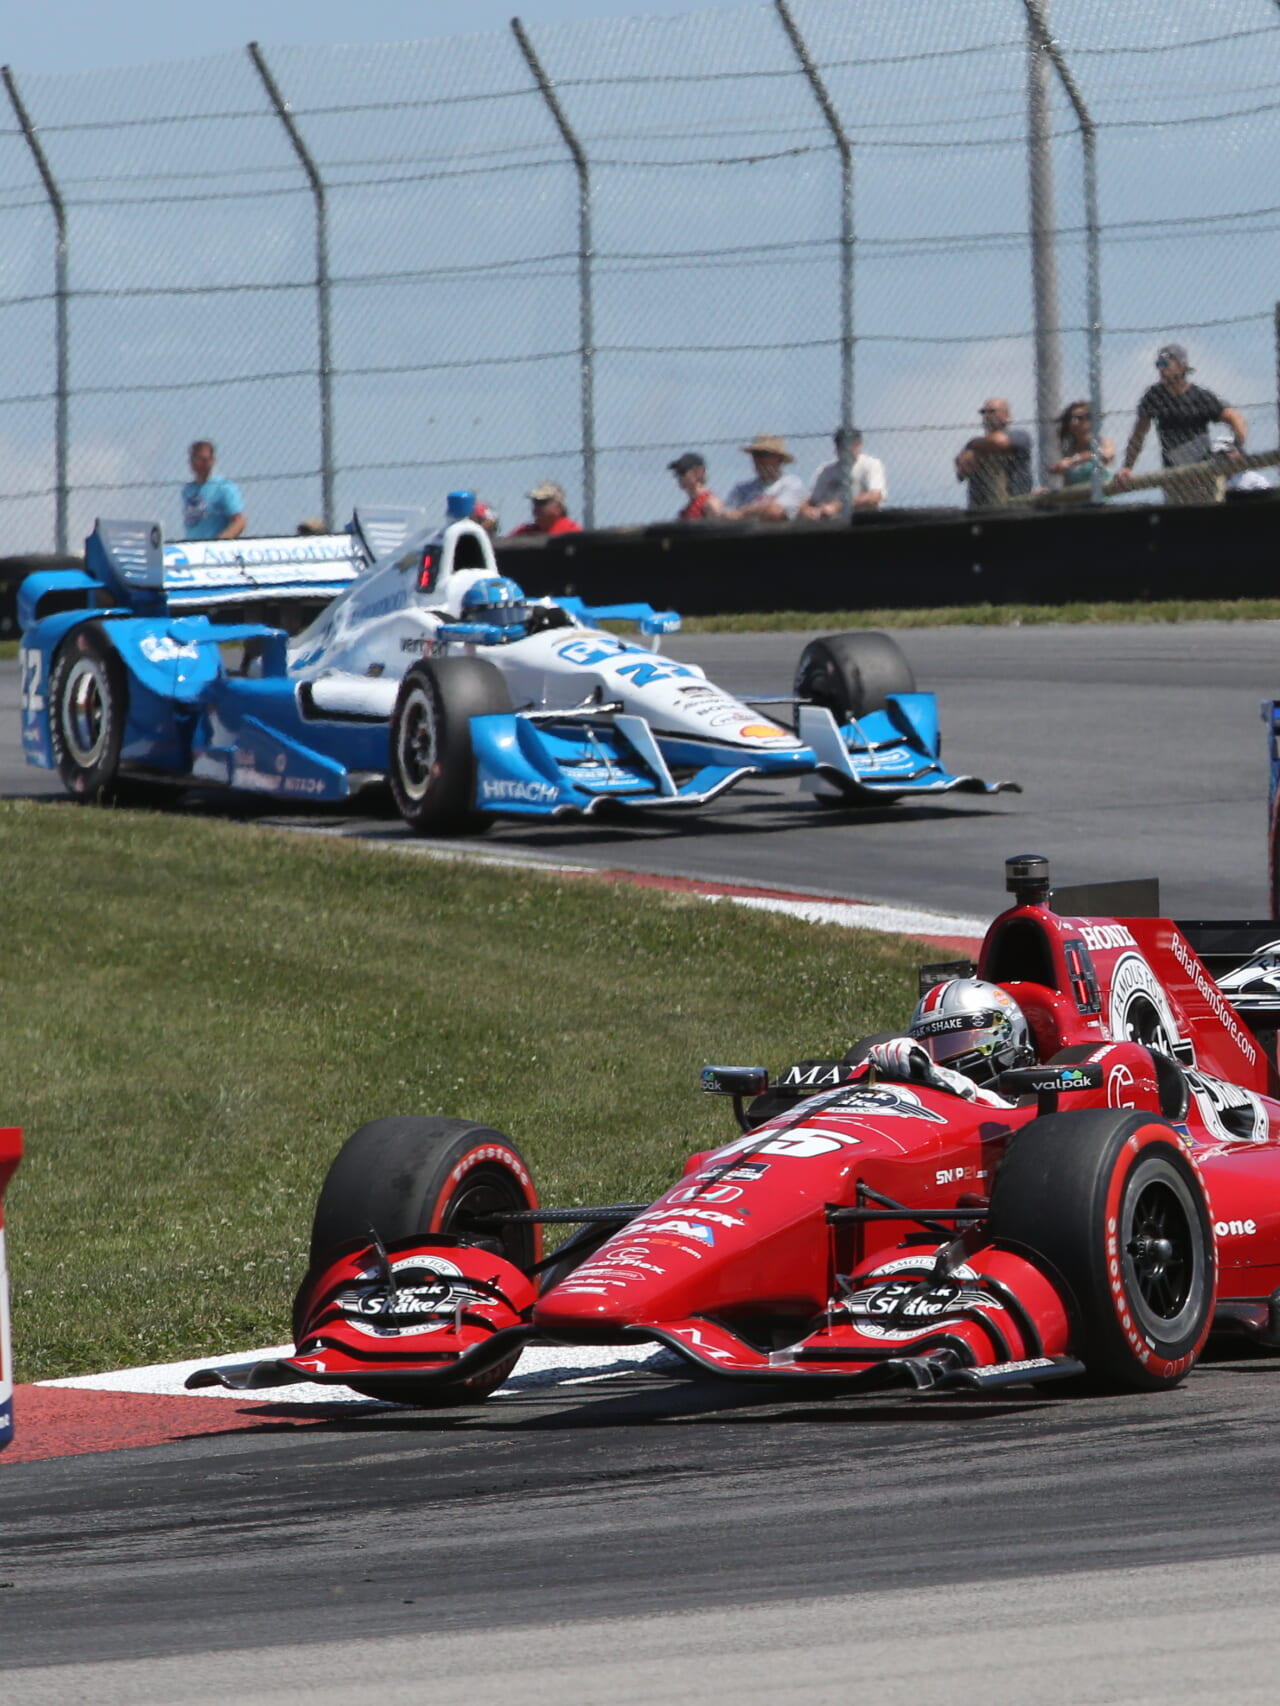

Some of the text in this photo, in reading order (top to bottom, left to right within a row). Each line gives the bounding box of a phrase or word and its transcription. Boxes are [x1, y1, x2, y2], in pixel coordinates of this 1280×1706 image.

[483, 779, 559, 801] HITACHI
[1113, 963, 1147, 1018] FAMOUS
[1169, 932, 1257, 1067] RahalTeamStore.com
[931, 1018, 962, 1033] SHAKE
[1032, 1076, 1092, 1090] valpak
[704, 1127, 863, 1158] 15
[453, 1147, 529, 1187] Firestone
